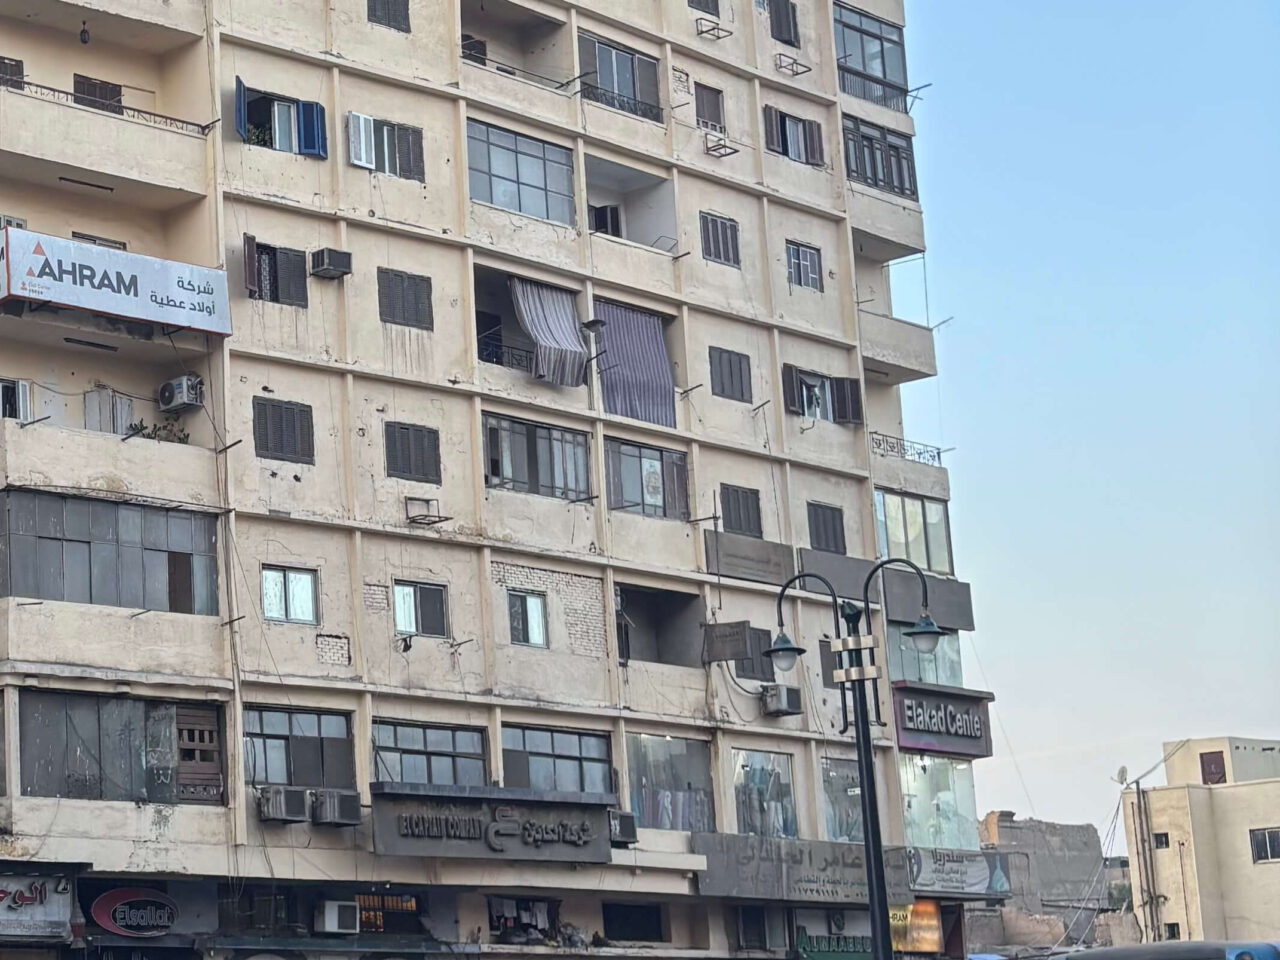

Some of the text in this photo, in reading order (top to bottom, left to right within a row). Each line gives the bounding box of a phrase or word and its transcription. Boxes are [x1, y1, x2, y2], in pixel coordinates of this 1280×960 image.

[36, 257, 139, 297] AHRAM
[177, 276, 214, 295] شركة
[150, 290, 216, 316] أولاد عطية
[904, 699, 946, 733] Elakad
